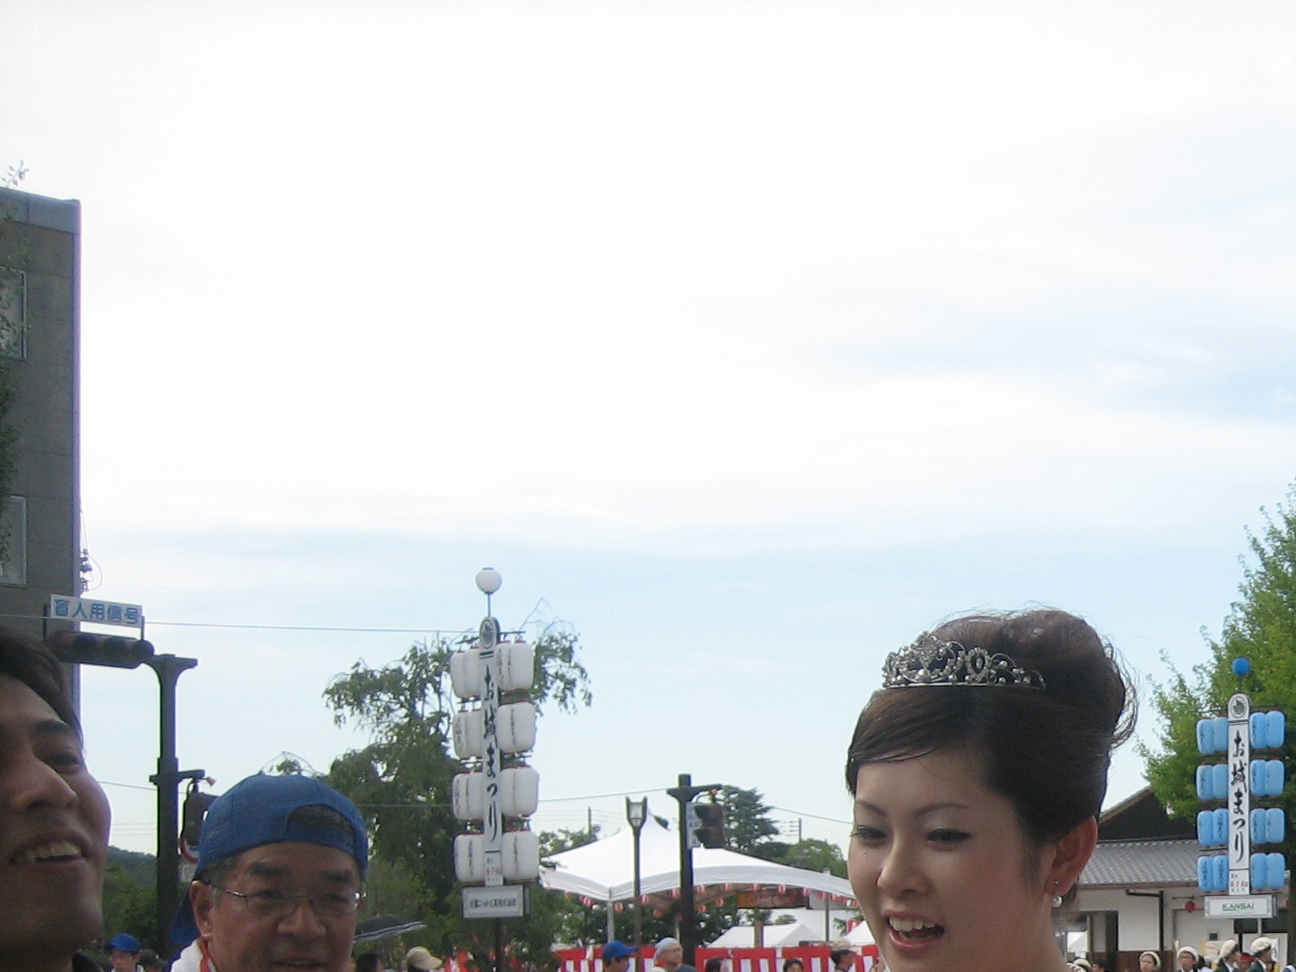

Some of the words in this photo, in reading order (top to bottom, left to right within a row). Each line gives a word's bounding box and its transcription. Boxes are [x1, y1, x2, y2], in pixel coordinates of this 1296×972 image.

[54, 599, 139, 624] 盲人用信号
[483, 664, 499, 842] お城まつり
[1230, 728, 1247, 863] お城まつり
[1222, 903, 1255, 911] KANSAI
